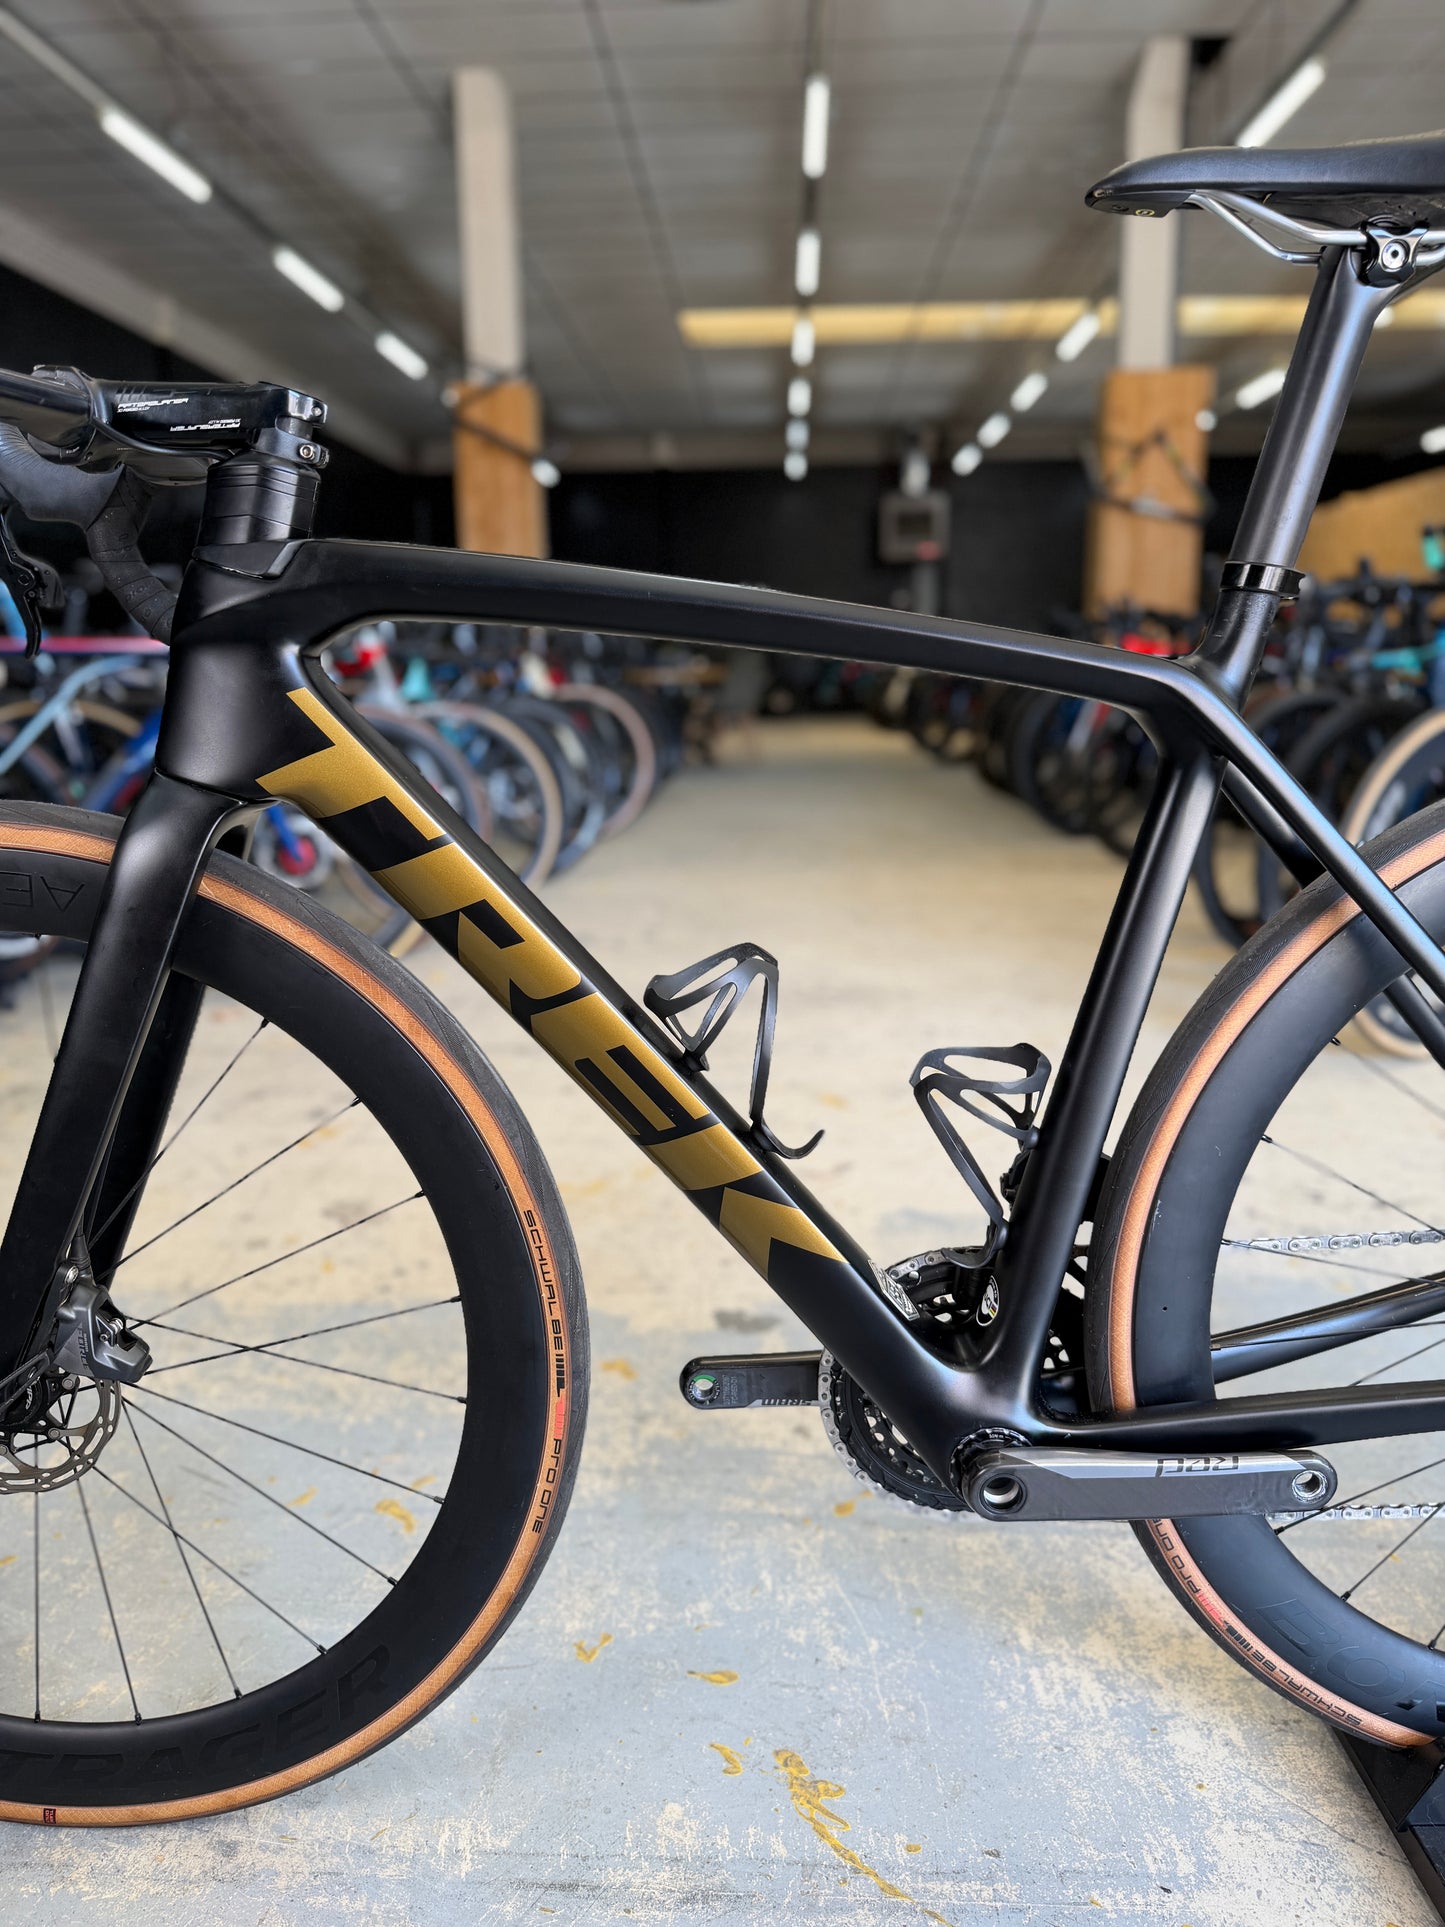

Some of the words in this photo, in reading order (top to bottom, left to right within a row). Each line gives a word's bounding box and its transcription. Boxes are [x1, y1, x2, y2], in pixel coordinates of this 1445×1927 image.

[255, 687, 850, 1283] TREK
[523, 1209, 563, 1350] SCHWALBE
[1252, 1649, 1363, 1727] SCHWALBE
